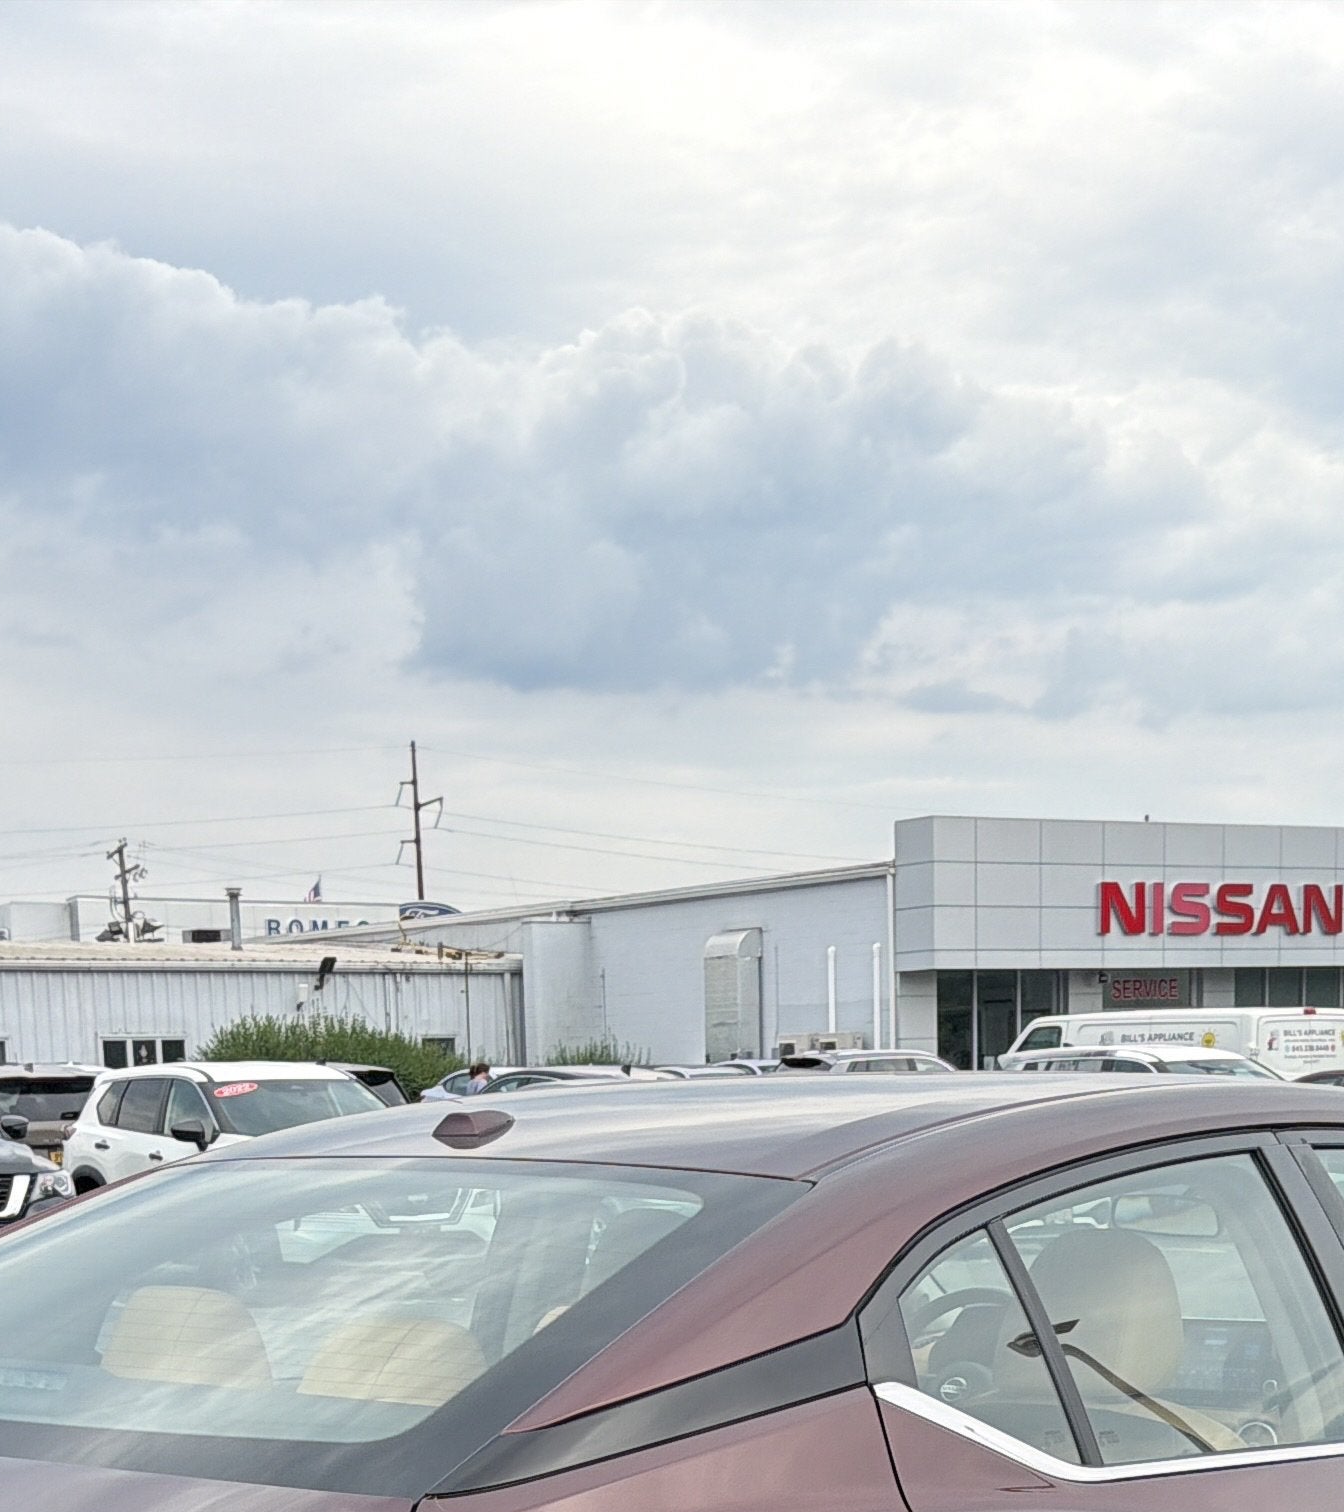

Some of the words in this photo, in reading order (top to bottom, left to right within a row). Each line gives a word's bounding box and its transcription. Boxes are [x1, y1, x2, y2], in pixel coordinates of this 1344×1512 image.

[1099, 881, 1344, 936] NISSAN
[1112, 978, 1179, 999] SERVICE
[1120, 1033, 1145, 1043] BILL'S
[1147, 1031, 1195, 1042] APPLIANCE
[1283, 1029, 1303, 1037] BILL'S
[1304, 1029, 1336, 1037] APPLIANCE
